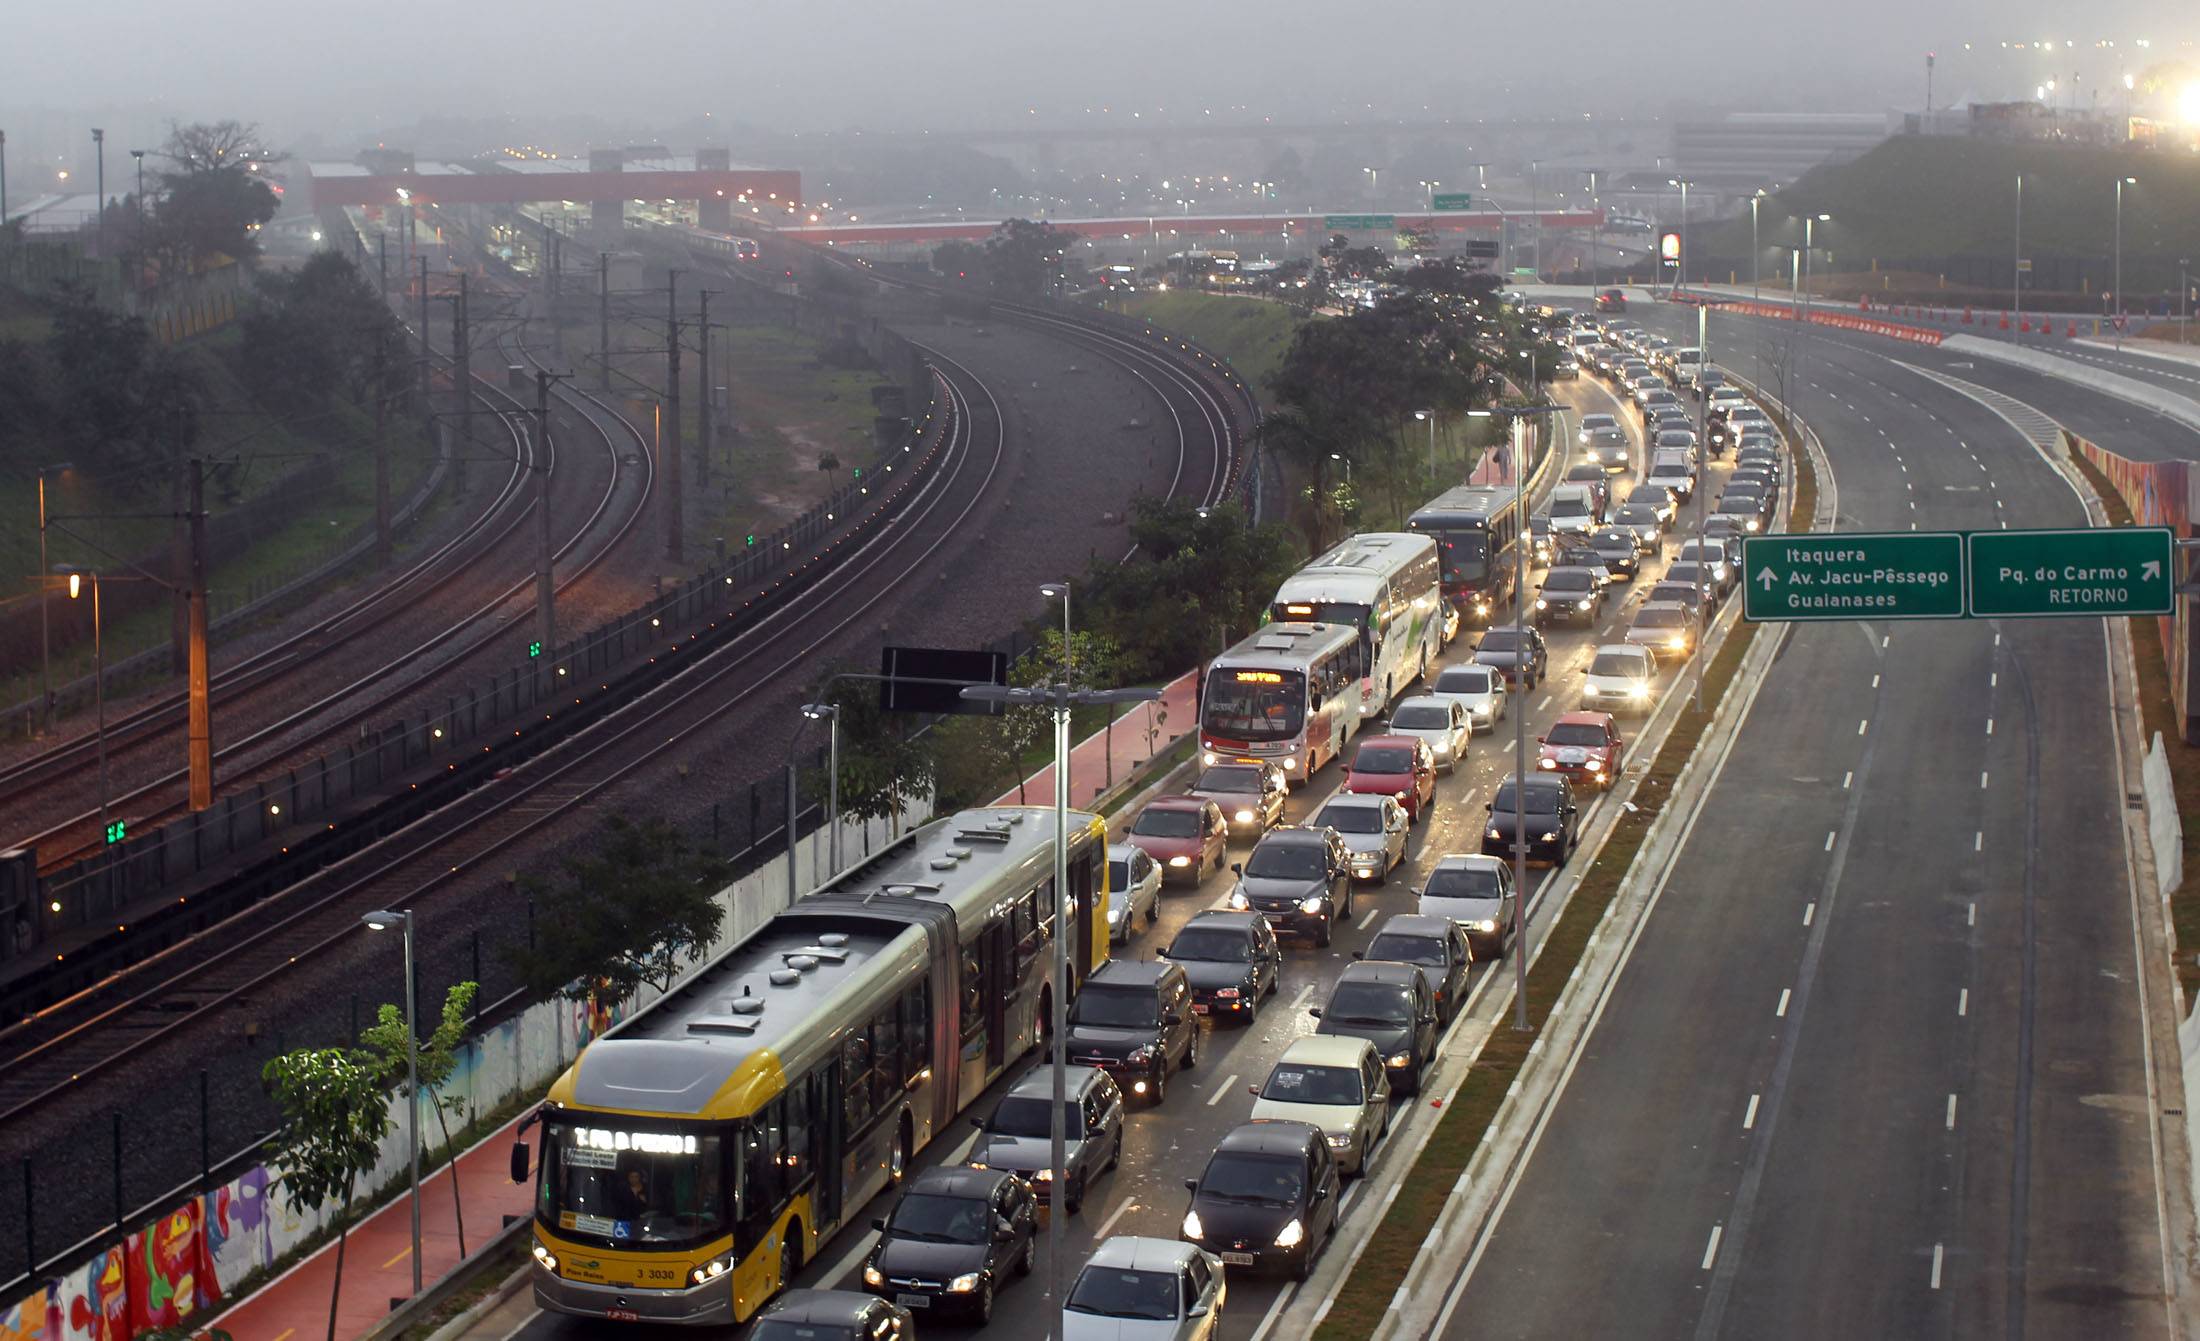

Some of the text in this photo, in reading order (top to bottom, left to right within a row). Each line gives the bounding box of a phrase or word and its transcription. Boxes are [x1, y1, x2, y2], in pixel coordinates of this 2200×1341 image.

[1786, 548, 1866, 565] Itaquera
[1788, 568, 1949, 587] Av. Jacu-Pêssego
[2000, 566, 2128, 584] Pq. do Carmo
[1787, 594, 1897, 607] Guaianases
[2050, 588, 2128, 603] RETORNO
[637, 1269, 674, 1280] 3 3030
